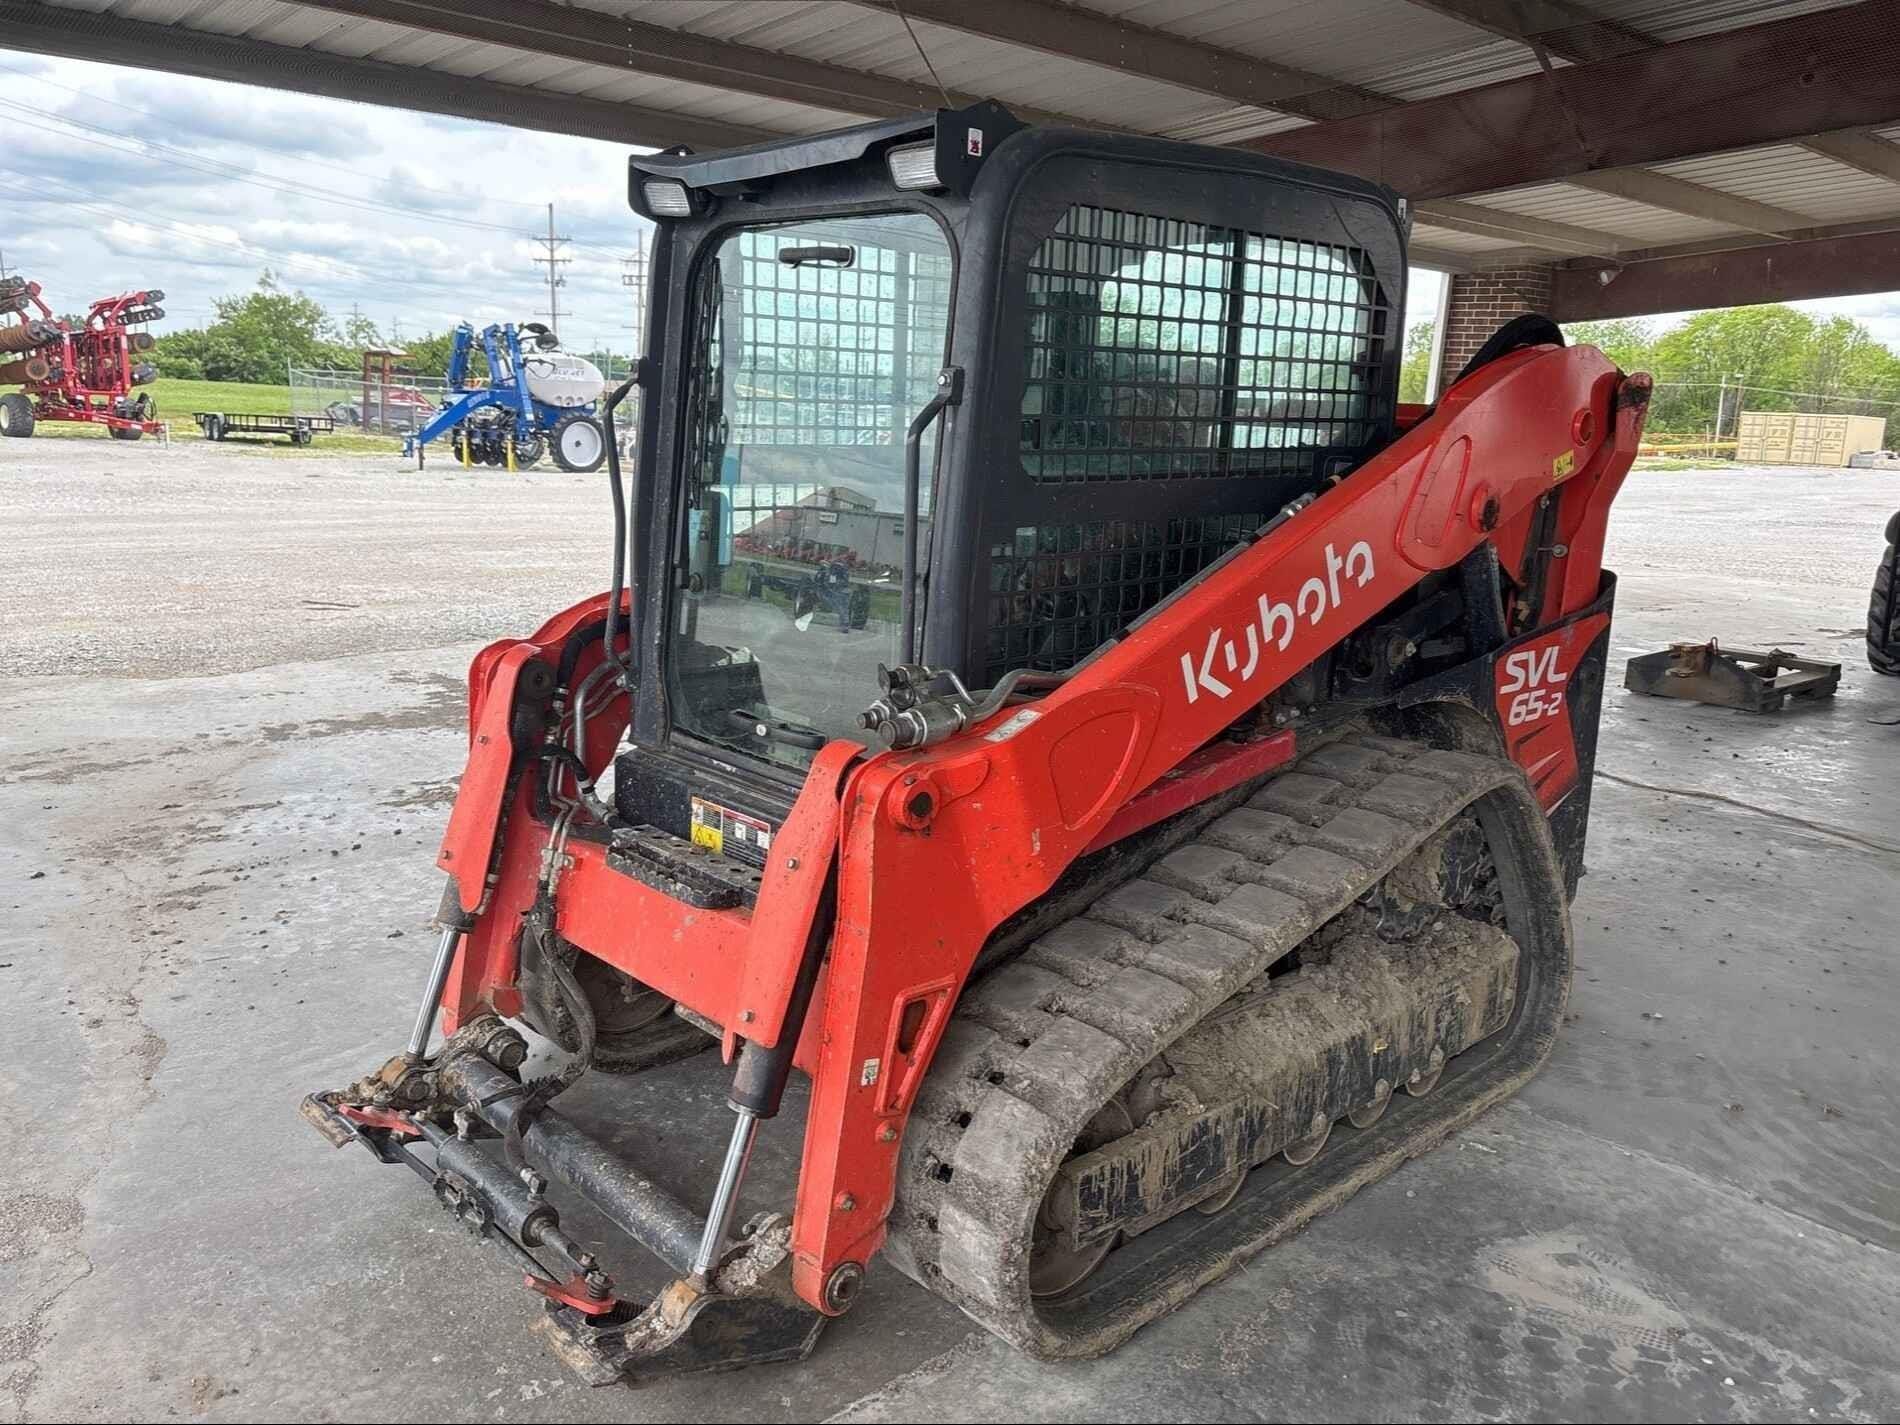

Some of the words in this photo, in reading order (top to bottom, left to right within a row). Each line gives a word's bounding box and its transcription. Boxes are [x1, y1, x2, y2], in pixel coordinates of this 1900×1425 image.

[1180, 541, 1375, 704] Kubota
[1500, 645, 1568, 694] SVL
[1508, 689, 1562, 726] 65-2
